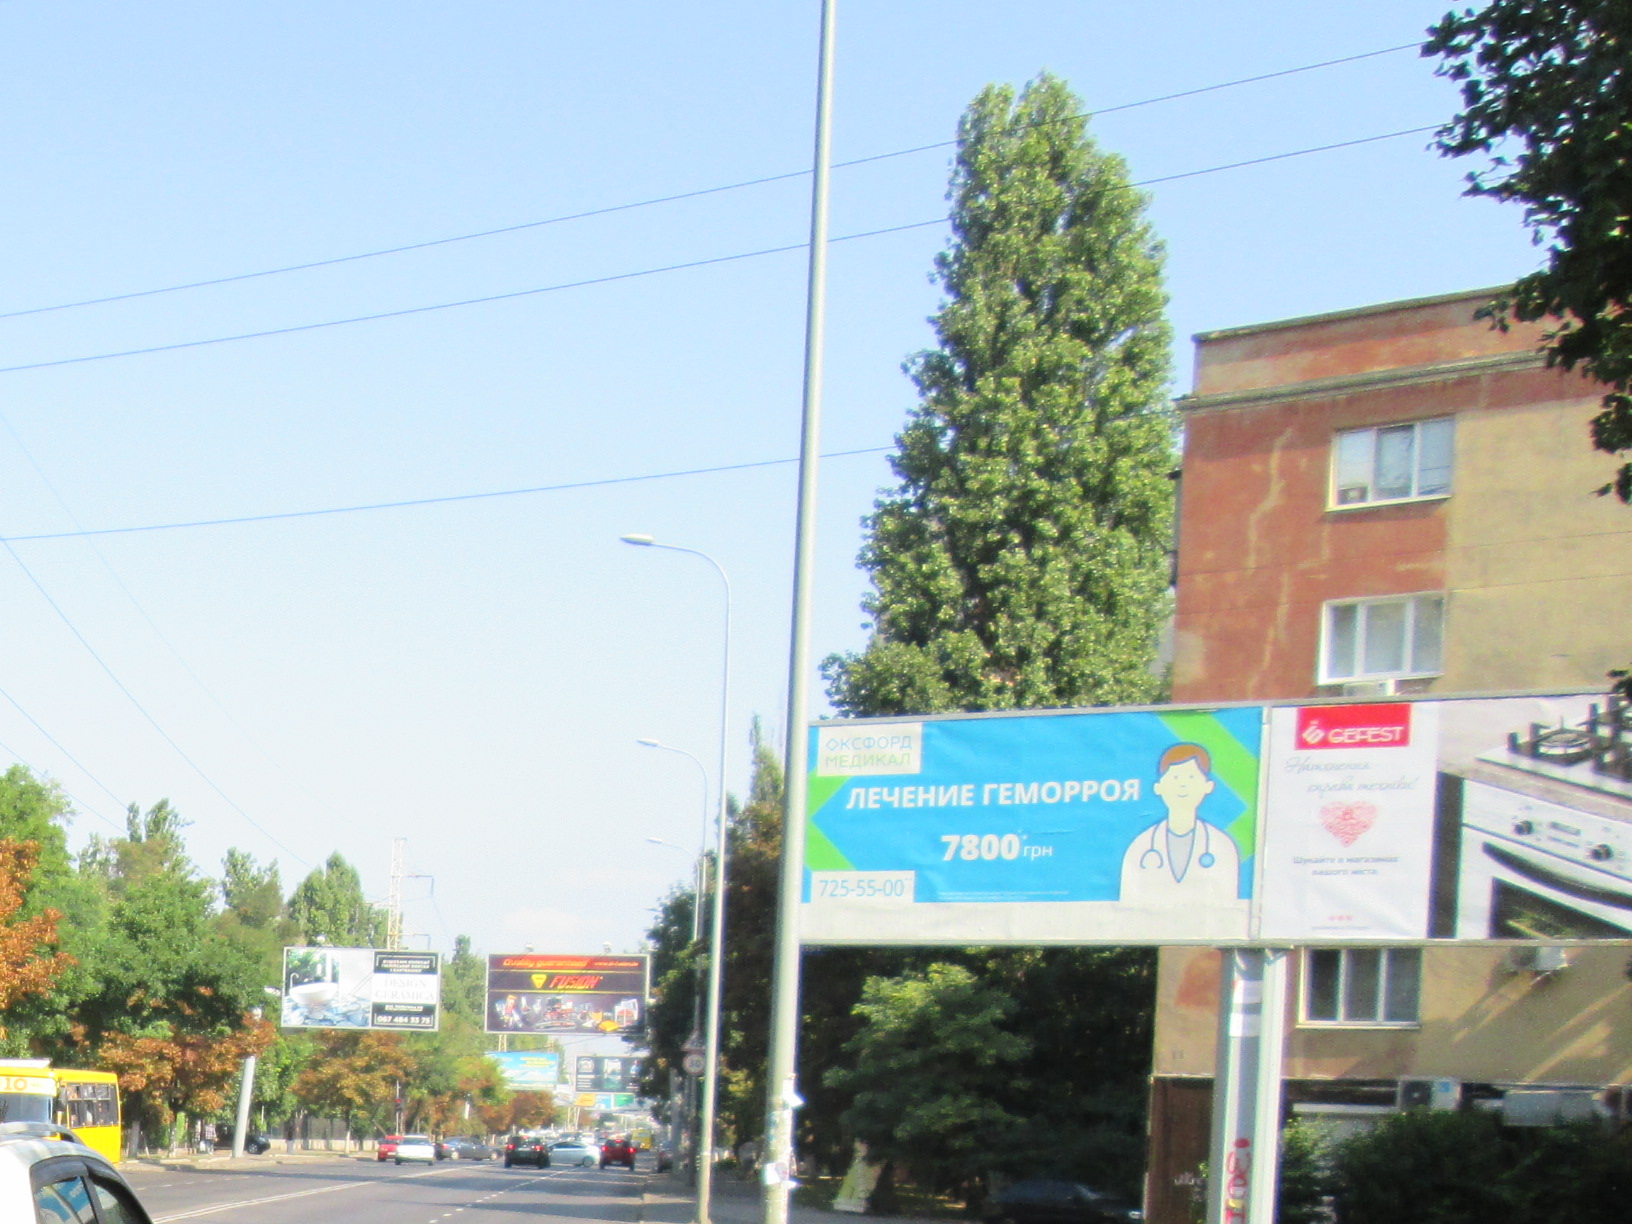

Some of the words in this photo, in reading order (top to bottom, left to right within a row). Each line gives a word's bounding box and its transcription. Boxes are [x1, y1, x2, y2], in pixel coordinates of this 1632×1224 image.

[826, 735, 912, 752] ОКСФОРД
[1328, 726, 1404, 744] GEFEST
[825, 752, 911, 769] МЕДИКАЛ
[845, 783, 976, 810] ЛЕЧЕНИЕ
[982, 778, 1141, 806] ГЕМОРРОЯ
[1023, 846, 1053, 861] грн
[819, 879, 905, 897] 725-55-00
[549, 975, 601, 989] FUSION
